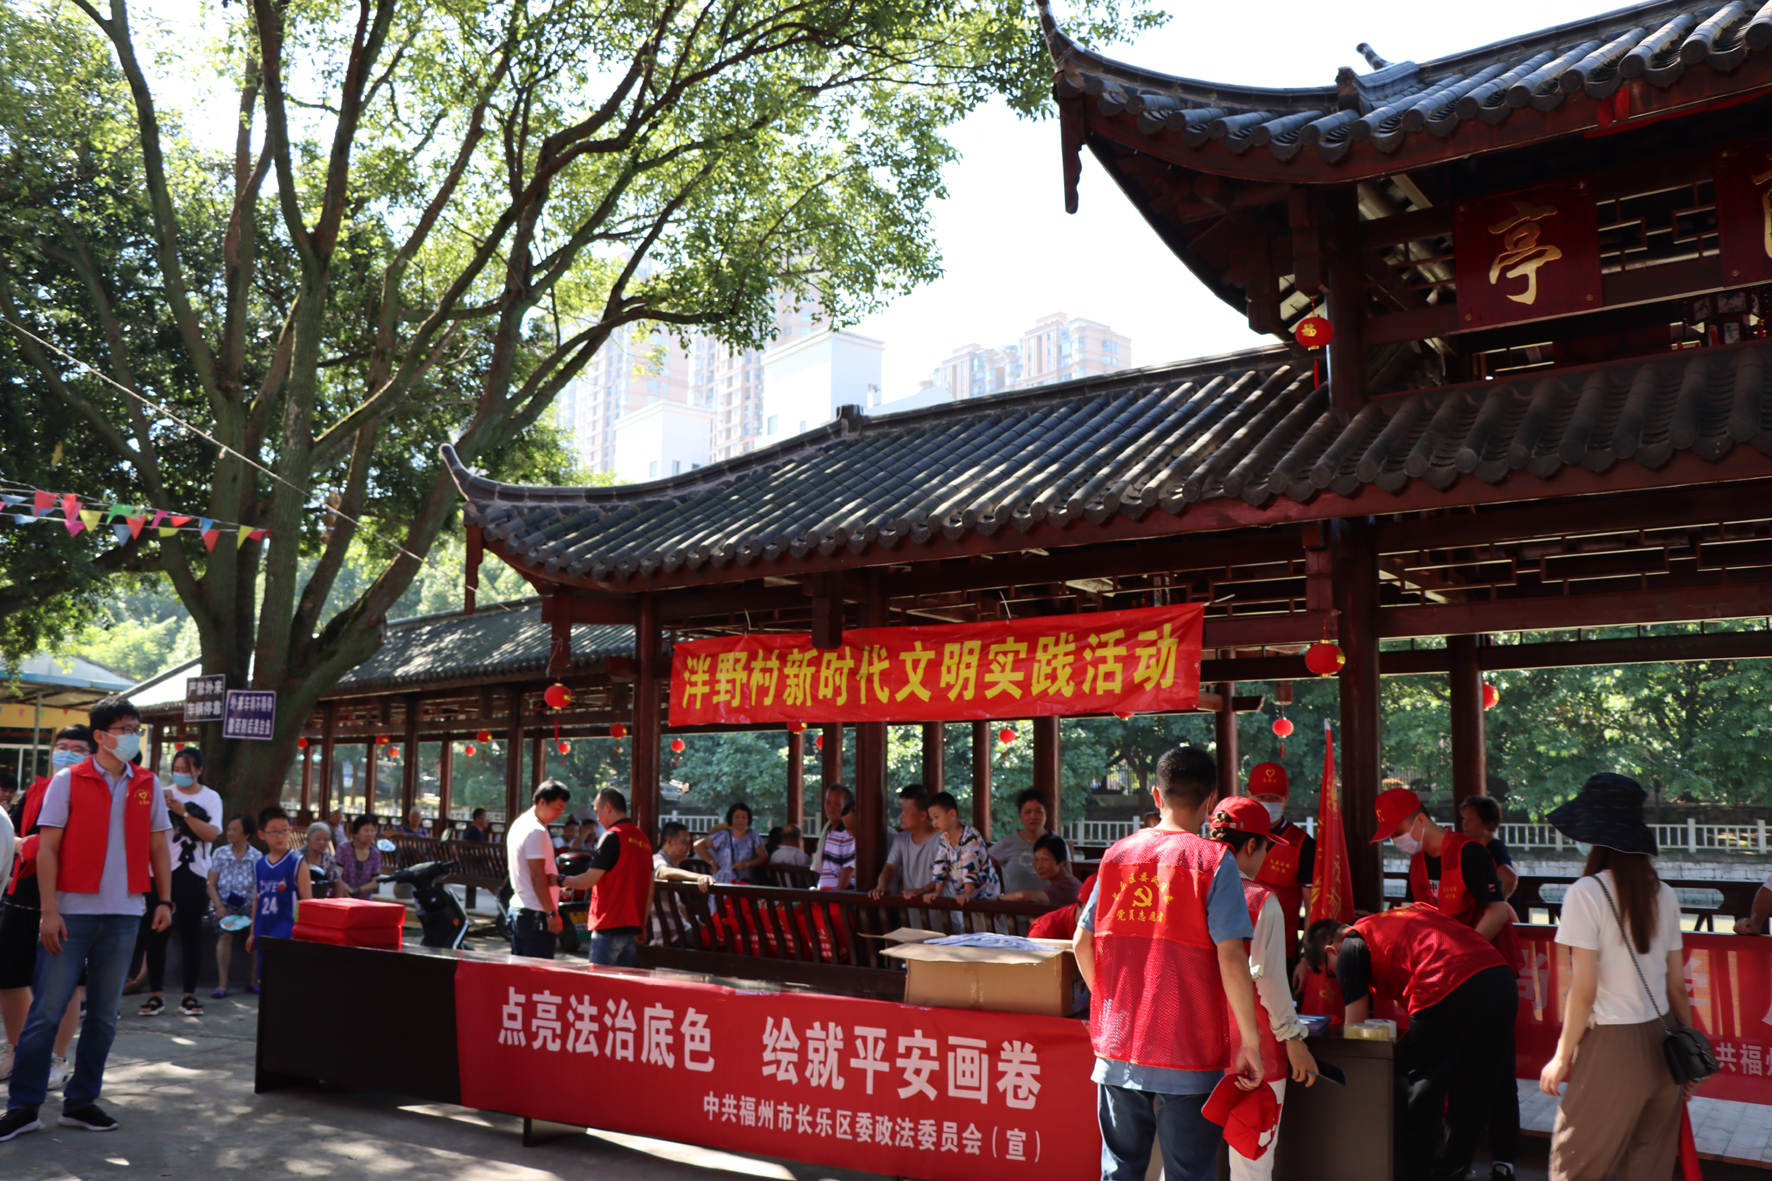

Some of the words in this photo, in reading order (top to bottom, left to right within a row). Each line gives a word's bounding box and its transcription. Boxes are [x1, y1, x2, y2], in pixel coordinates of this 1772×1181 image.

[1488, 201, 1562, 305] 亭
[682, 623, 1179, 709] 泮野村新时代文明实践活动
[262, 897, 278, 915] 24
[1117, 909, 1164, 923] 党员志愿者
[498, 986, 715, 1072] 点亮法治底色
[762, 1016, 1041, 1110] 绘就平安画卷
